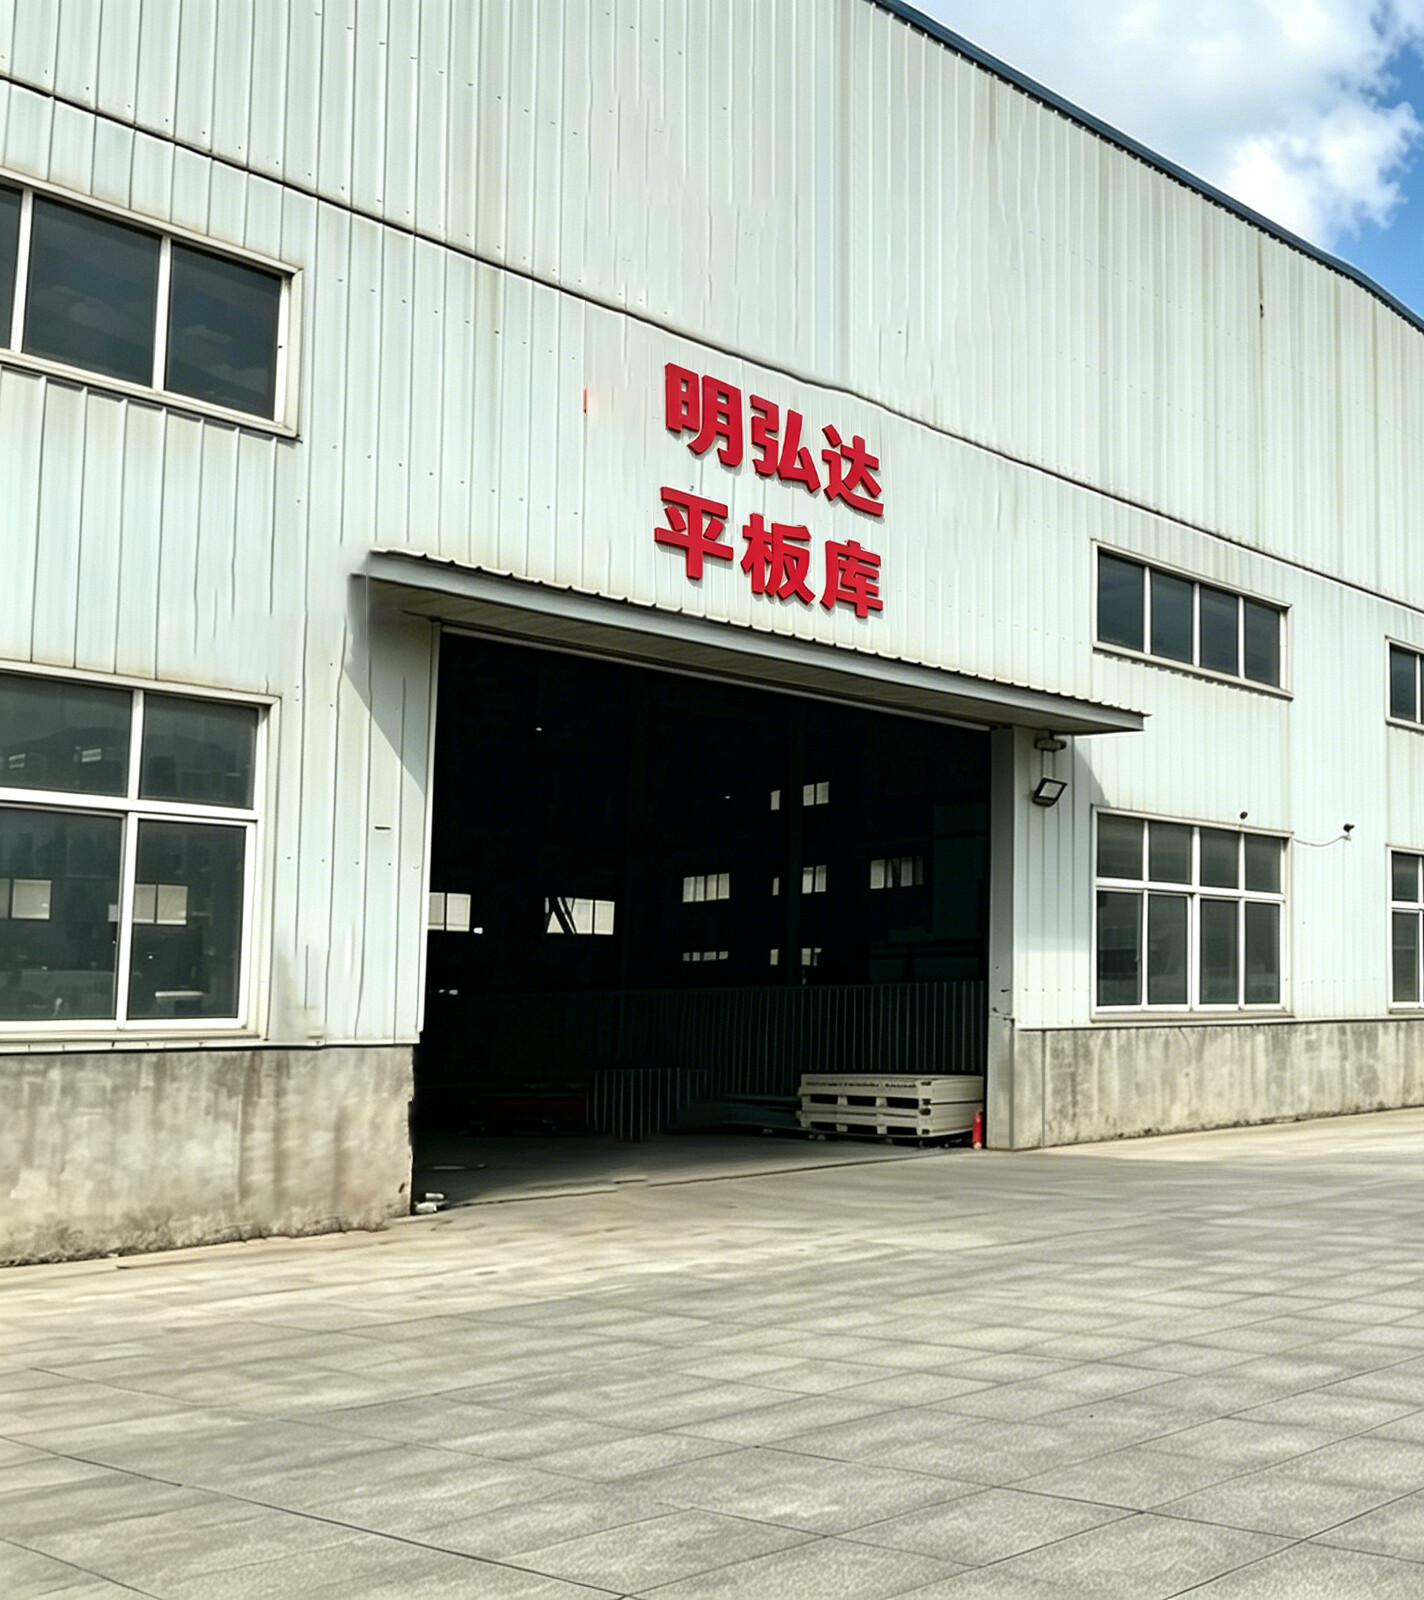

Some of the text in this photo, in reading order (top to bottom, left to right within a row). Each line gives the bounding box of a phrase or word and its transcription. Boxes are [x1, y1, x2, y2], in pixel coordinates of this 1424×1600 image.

[664, 362, 885, 517] 明弘达
[653, 486, 885, 619] 平板库
